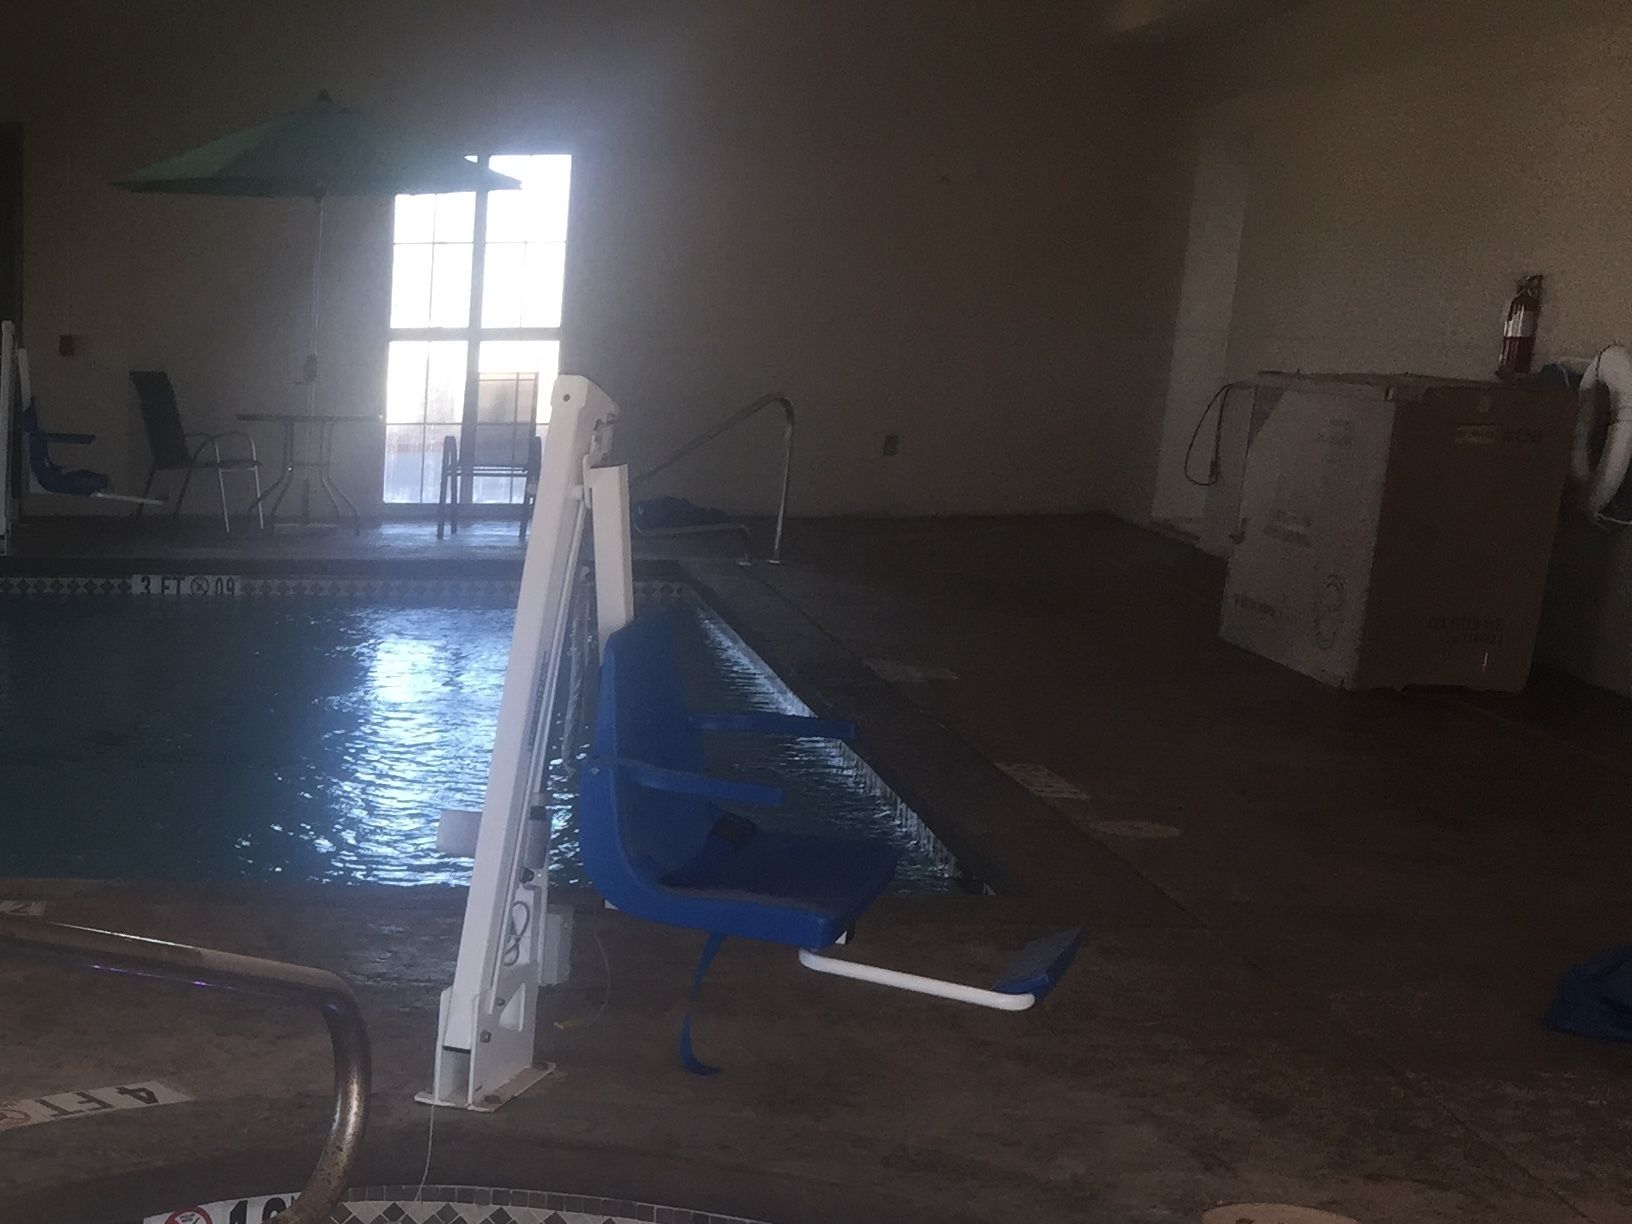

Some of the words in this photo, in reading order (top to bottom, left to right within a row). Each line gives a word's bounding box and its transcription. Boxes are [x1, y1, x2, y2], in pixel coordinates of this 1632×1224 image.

[161, 576, 186, 595] FT
[33, 1091, 114, 1118] FT
[116, 1086, 160, 1105] 4
